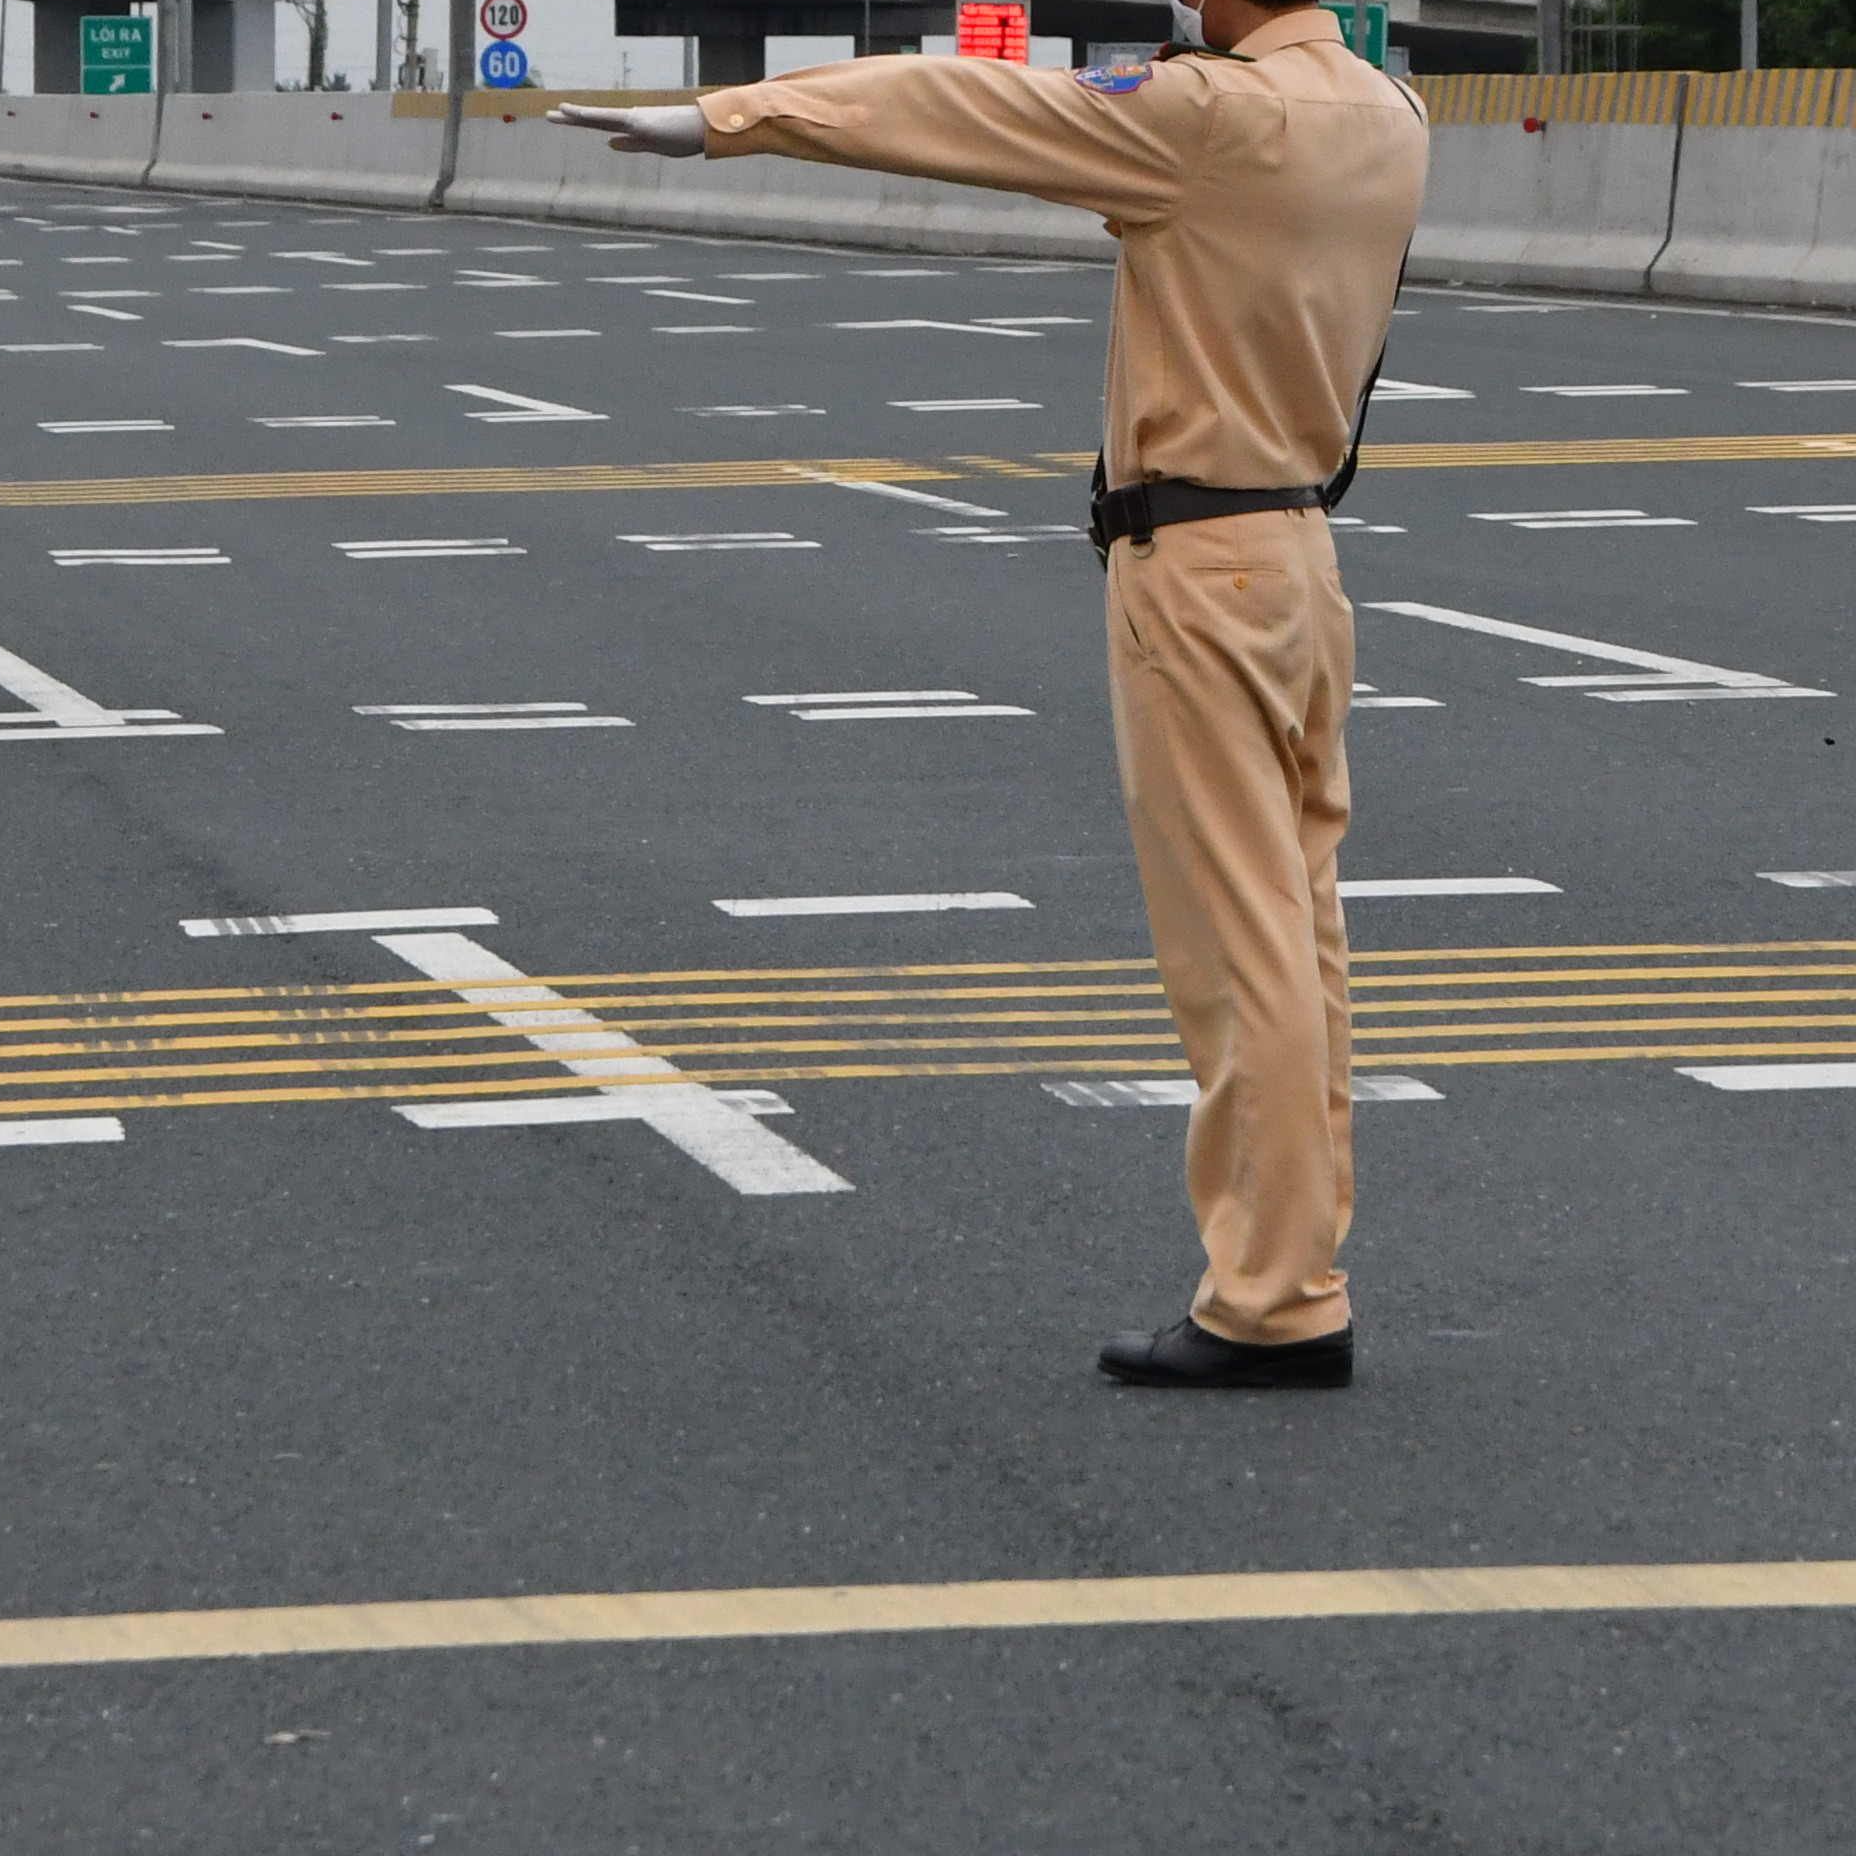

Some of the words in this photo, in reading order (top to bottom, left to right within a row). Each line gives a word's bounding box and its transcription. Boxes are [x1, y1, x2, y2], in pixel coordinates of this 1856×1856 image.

[489, 5, 519, 26] 120
[120, 28, 142, 42] RA
[101, 47, 131, 59] EXIT
[488, 50, 520, 79] 60
